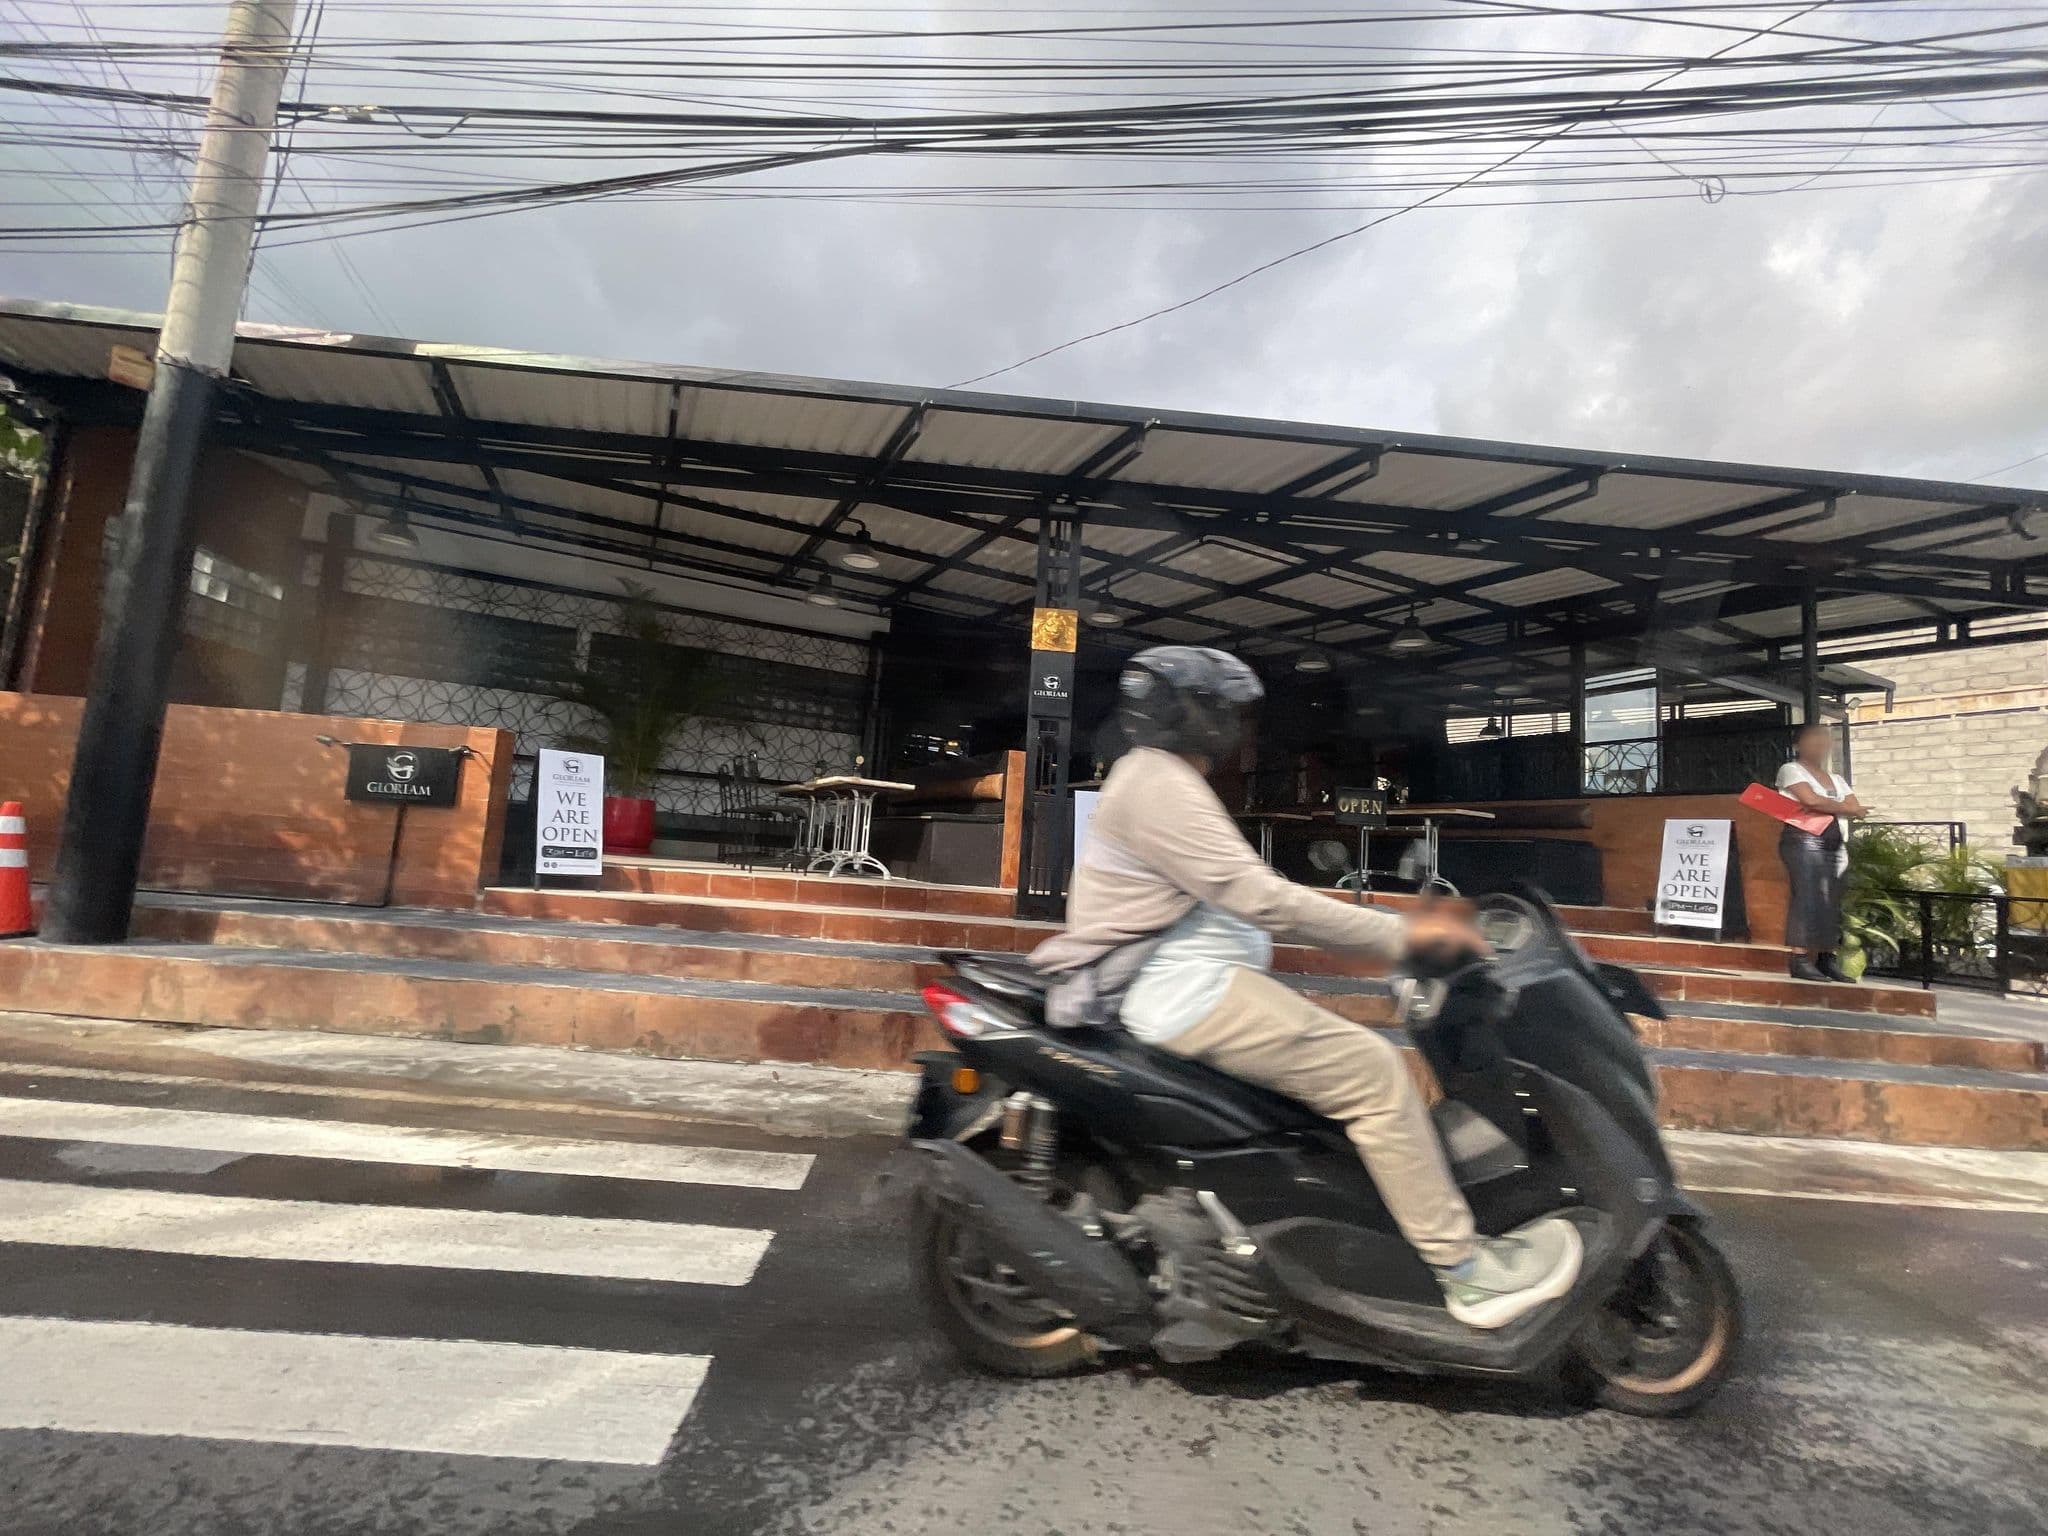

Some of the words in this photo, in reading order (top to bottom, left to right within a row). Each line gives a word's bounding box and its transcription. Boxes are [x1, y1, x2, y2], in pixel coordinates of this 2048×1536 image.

[1033, 690, 1068, 698] GLORIAM
[367, 782, 431, 796] GLORIAM
[556, 790, 586, 807] WE
[1338, 798, 1382, 815] OPEN
[552, 809, 590, 824] ARE
[542, 826, 597, 843] OPEN
[1679, 853, 1709, 867] WE
[1672, 869, 1711, 883] ARE
[1663, 884, 1719, 899] OPEN
